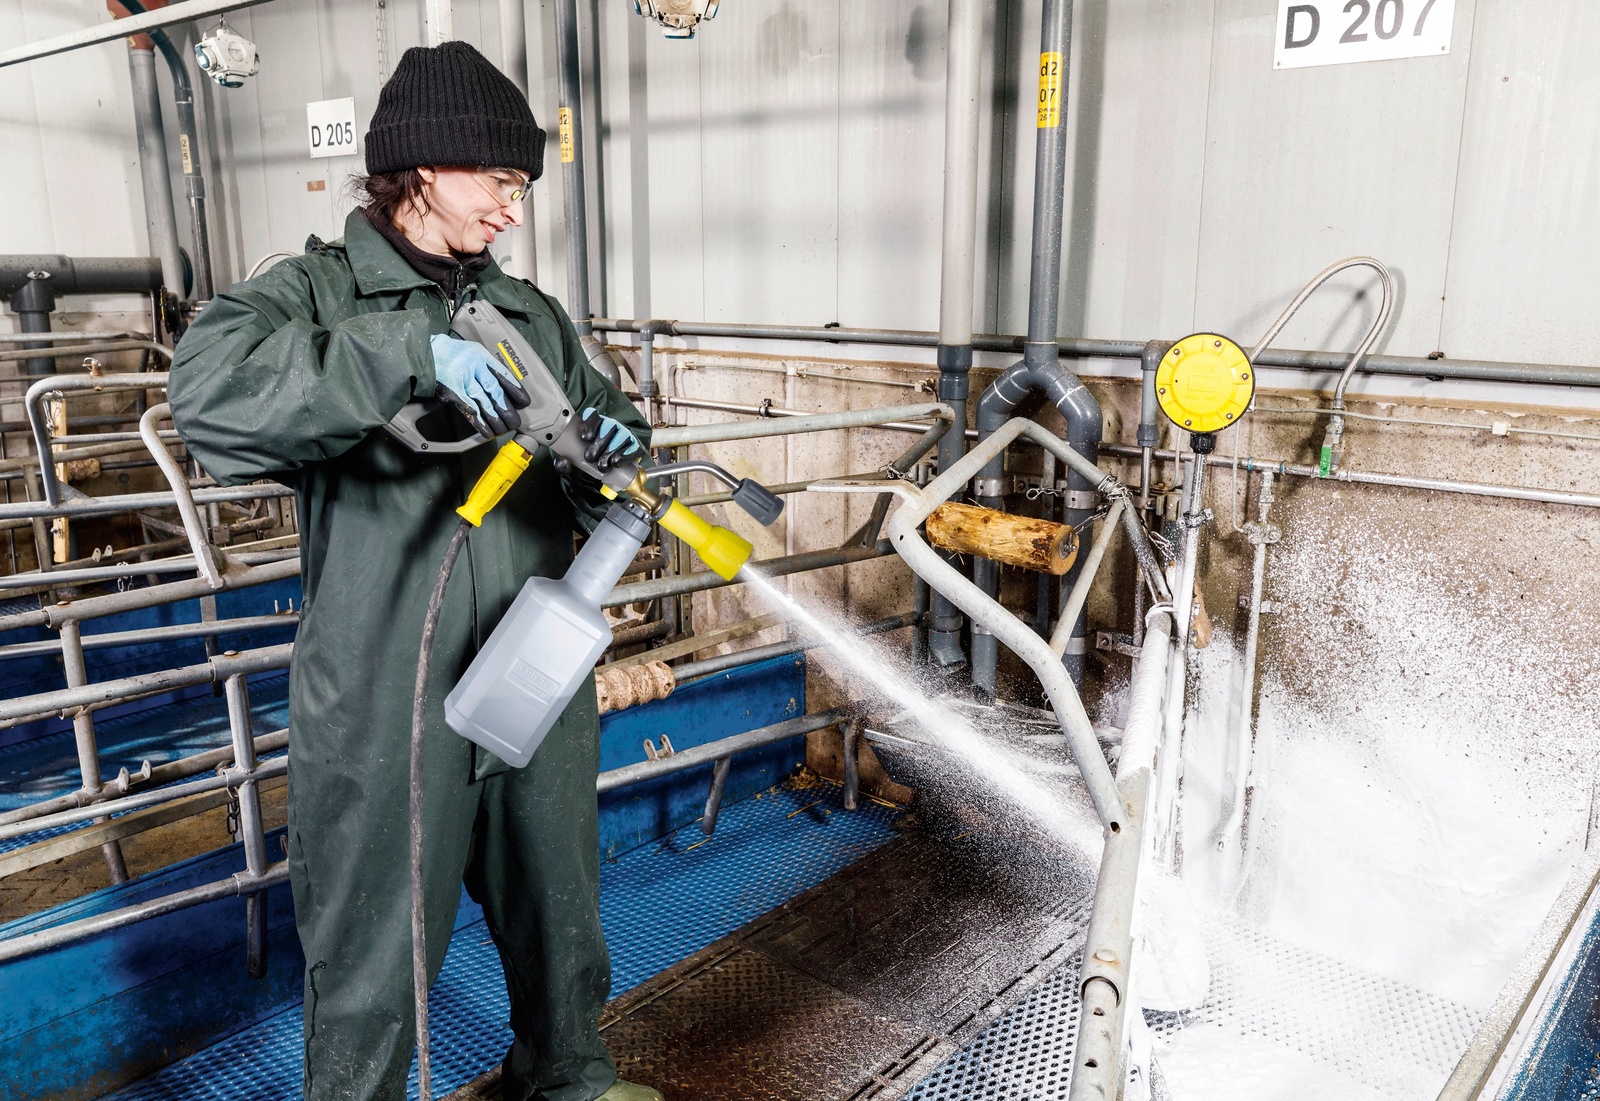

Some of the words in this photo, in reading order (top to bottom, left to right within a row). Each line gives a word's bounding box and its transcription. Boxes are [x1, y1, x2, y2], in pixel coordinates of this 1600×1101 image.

[1284, 4, 1321, 49] D
[1338, 0, 1437, 44] 207
[311, 125, 322, 148] D
[326, 121, 353, 146] 205
